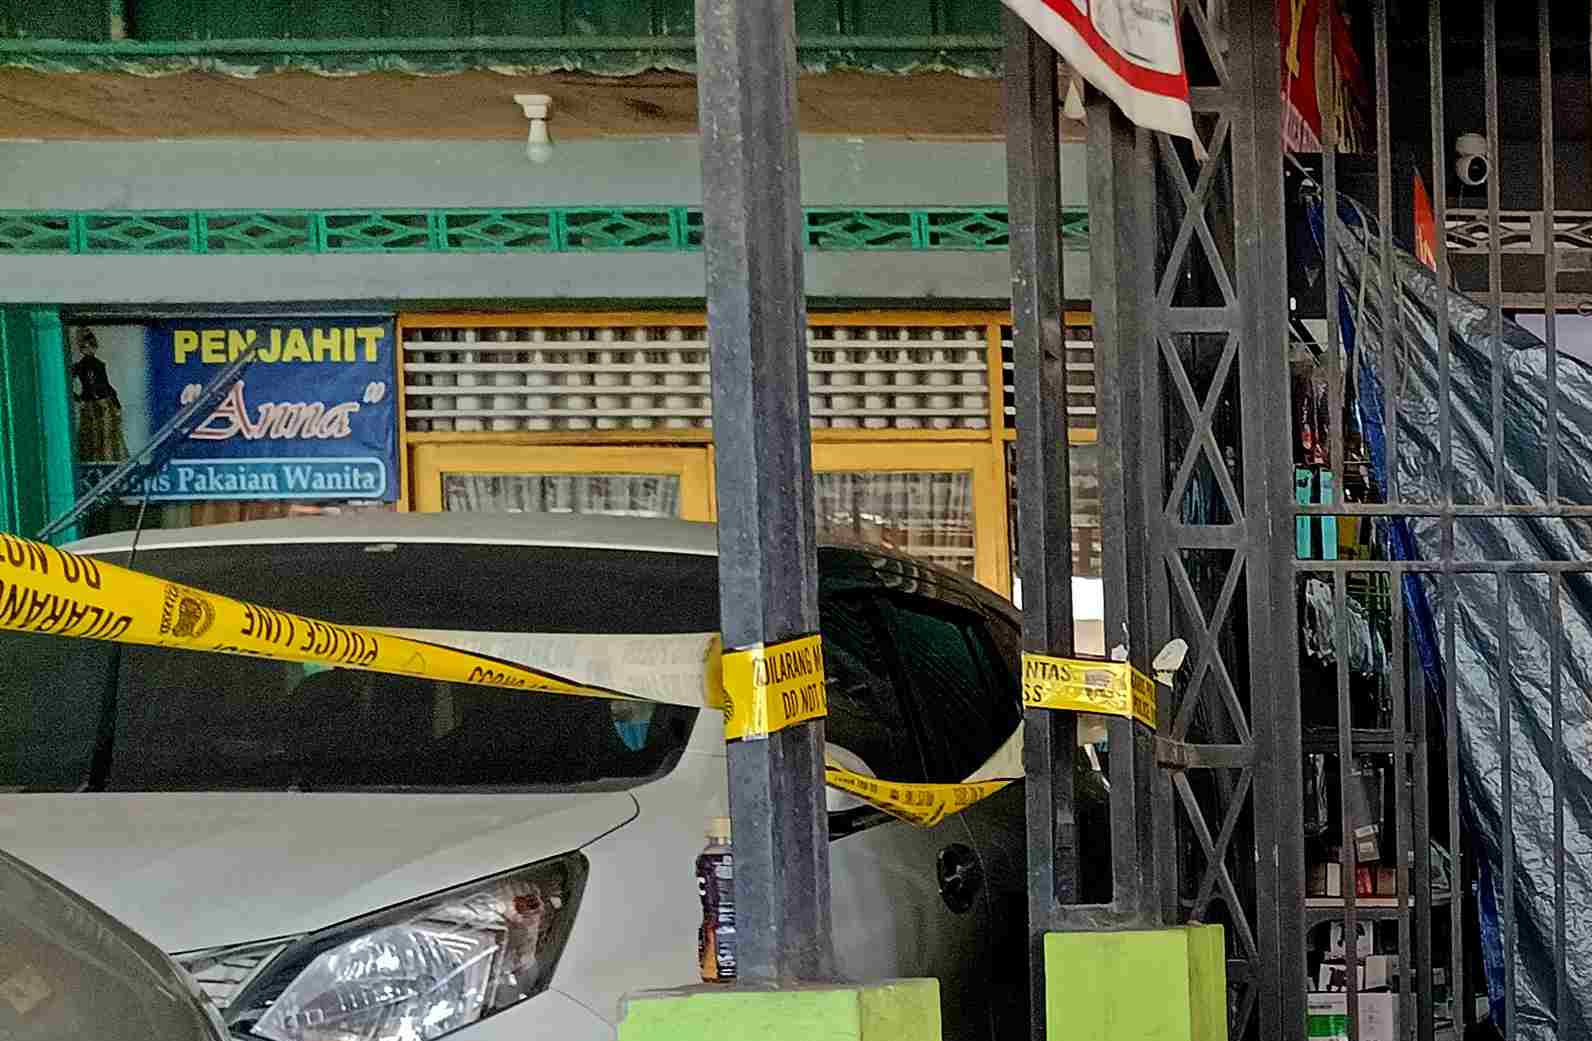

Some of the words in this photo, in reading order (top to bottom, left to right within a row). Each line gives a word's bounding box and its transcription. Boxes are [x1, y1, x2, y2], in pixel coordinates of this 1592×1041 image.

[174, 326, 385, 364] PENJAHIT
[177, 465, 279, 494] Pakaian
[281, 465, 376, 491] Wanita
[58, 548, 102, 590] DO
[782, 689, 799, 719] DO
